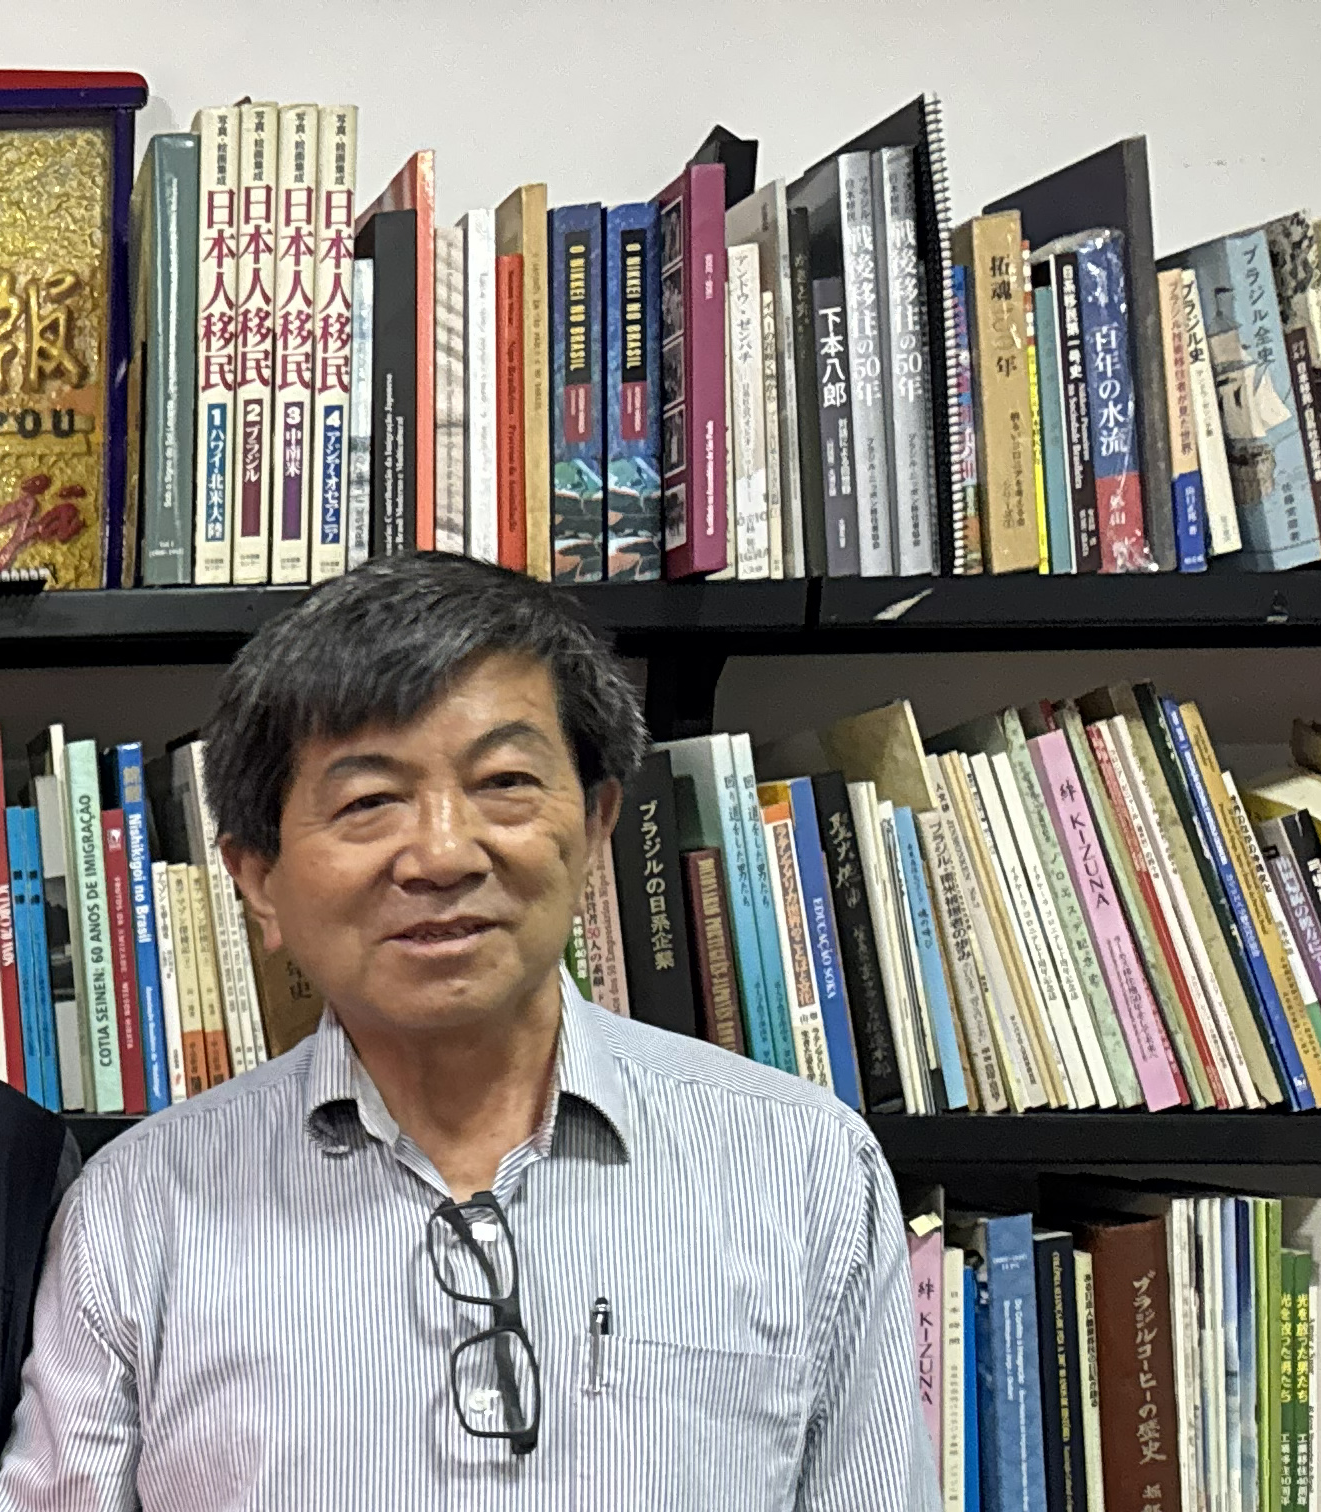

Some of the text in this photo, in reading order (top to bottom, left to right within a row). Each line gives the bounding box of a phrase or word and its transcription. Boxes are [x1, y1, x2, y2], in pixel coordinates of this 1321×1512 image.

[201, 188, 236, 393] 日本人移民
[236, 184, 274, 390] 日本人移民
[277, 186, 315, 393] 日本人移民
[317, 188, 355, 395] 日本人移民
[570, 258, 586, 301] NIKKEI
[626, 256, 642, 299] NIKKEI
[849, 223, 881, 407] 戦後移住の50年
[889, 218, 923, 403] 戦後移住の50年
[1181, 279, 1206, 364] ブラジル史
[1243, 246, 1276, 369] ブラジル全史
[570, 326, 586, 372] BRASIL
[626, 325, 642, 370] BRASIL
[818, 306, 848, 409] 下本八郎
[1094, 323, 1128, 457] 百年の水流
[210, 408, 222, 426] 1
[244, 403, 262, 483] 2 ブラジル
[285, 406, 302, 425] 3
[325, 410, 342, 428] 4
[129, 813, 152, 943] Nishikigoi no Brasil
[639, 800, 676, 971] ブラジルの日系企業
[1059, 779, 1111, 910] 絆 KIZUNA
[78, 794, 112, 1067] COTIA SEINEN: 60 ANOS DE IMIGRAÇÃO
[812, 897, 837, 999] EDUCAÇÃO SOKA
[916, 1276, 936, 1406] 絆 KIZUNA
